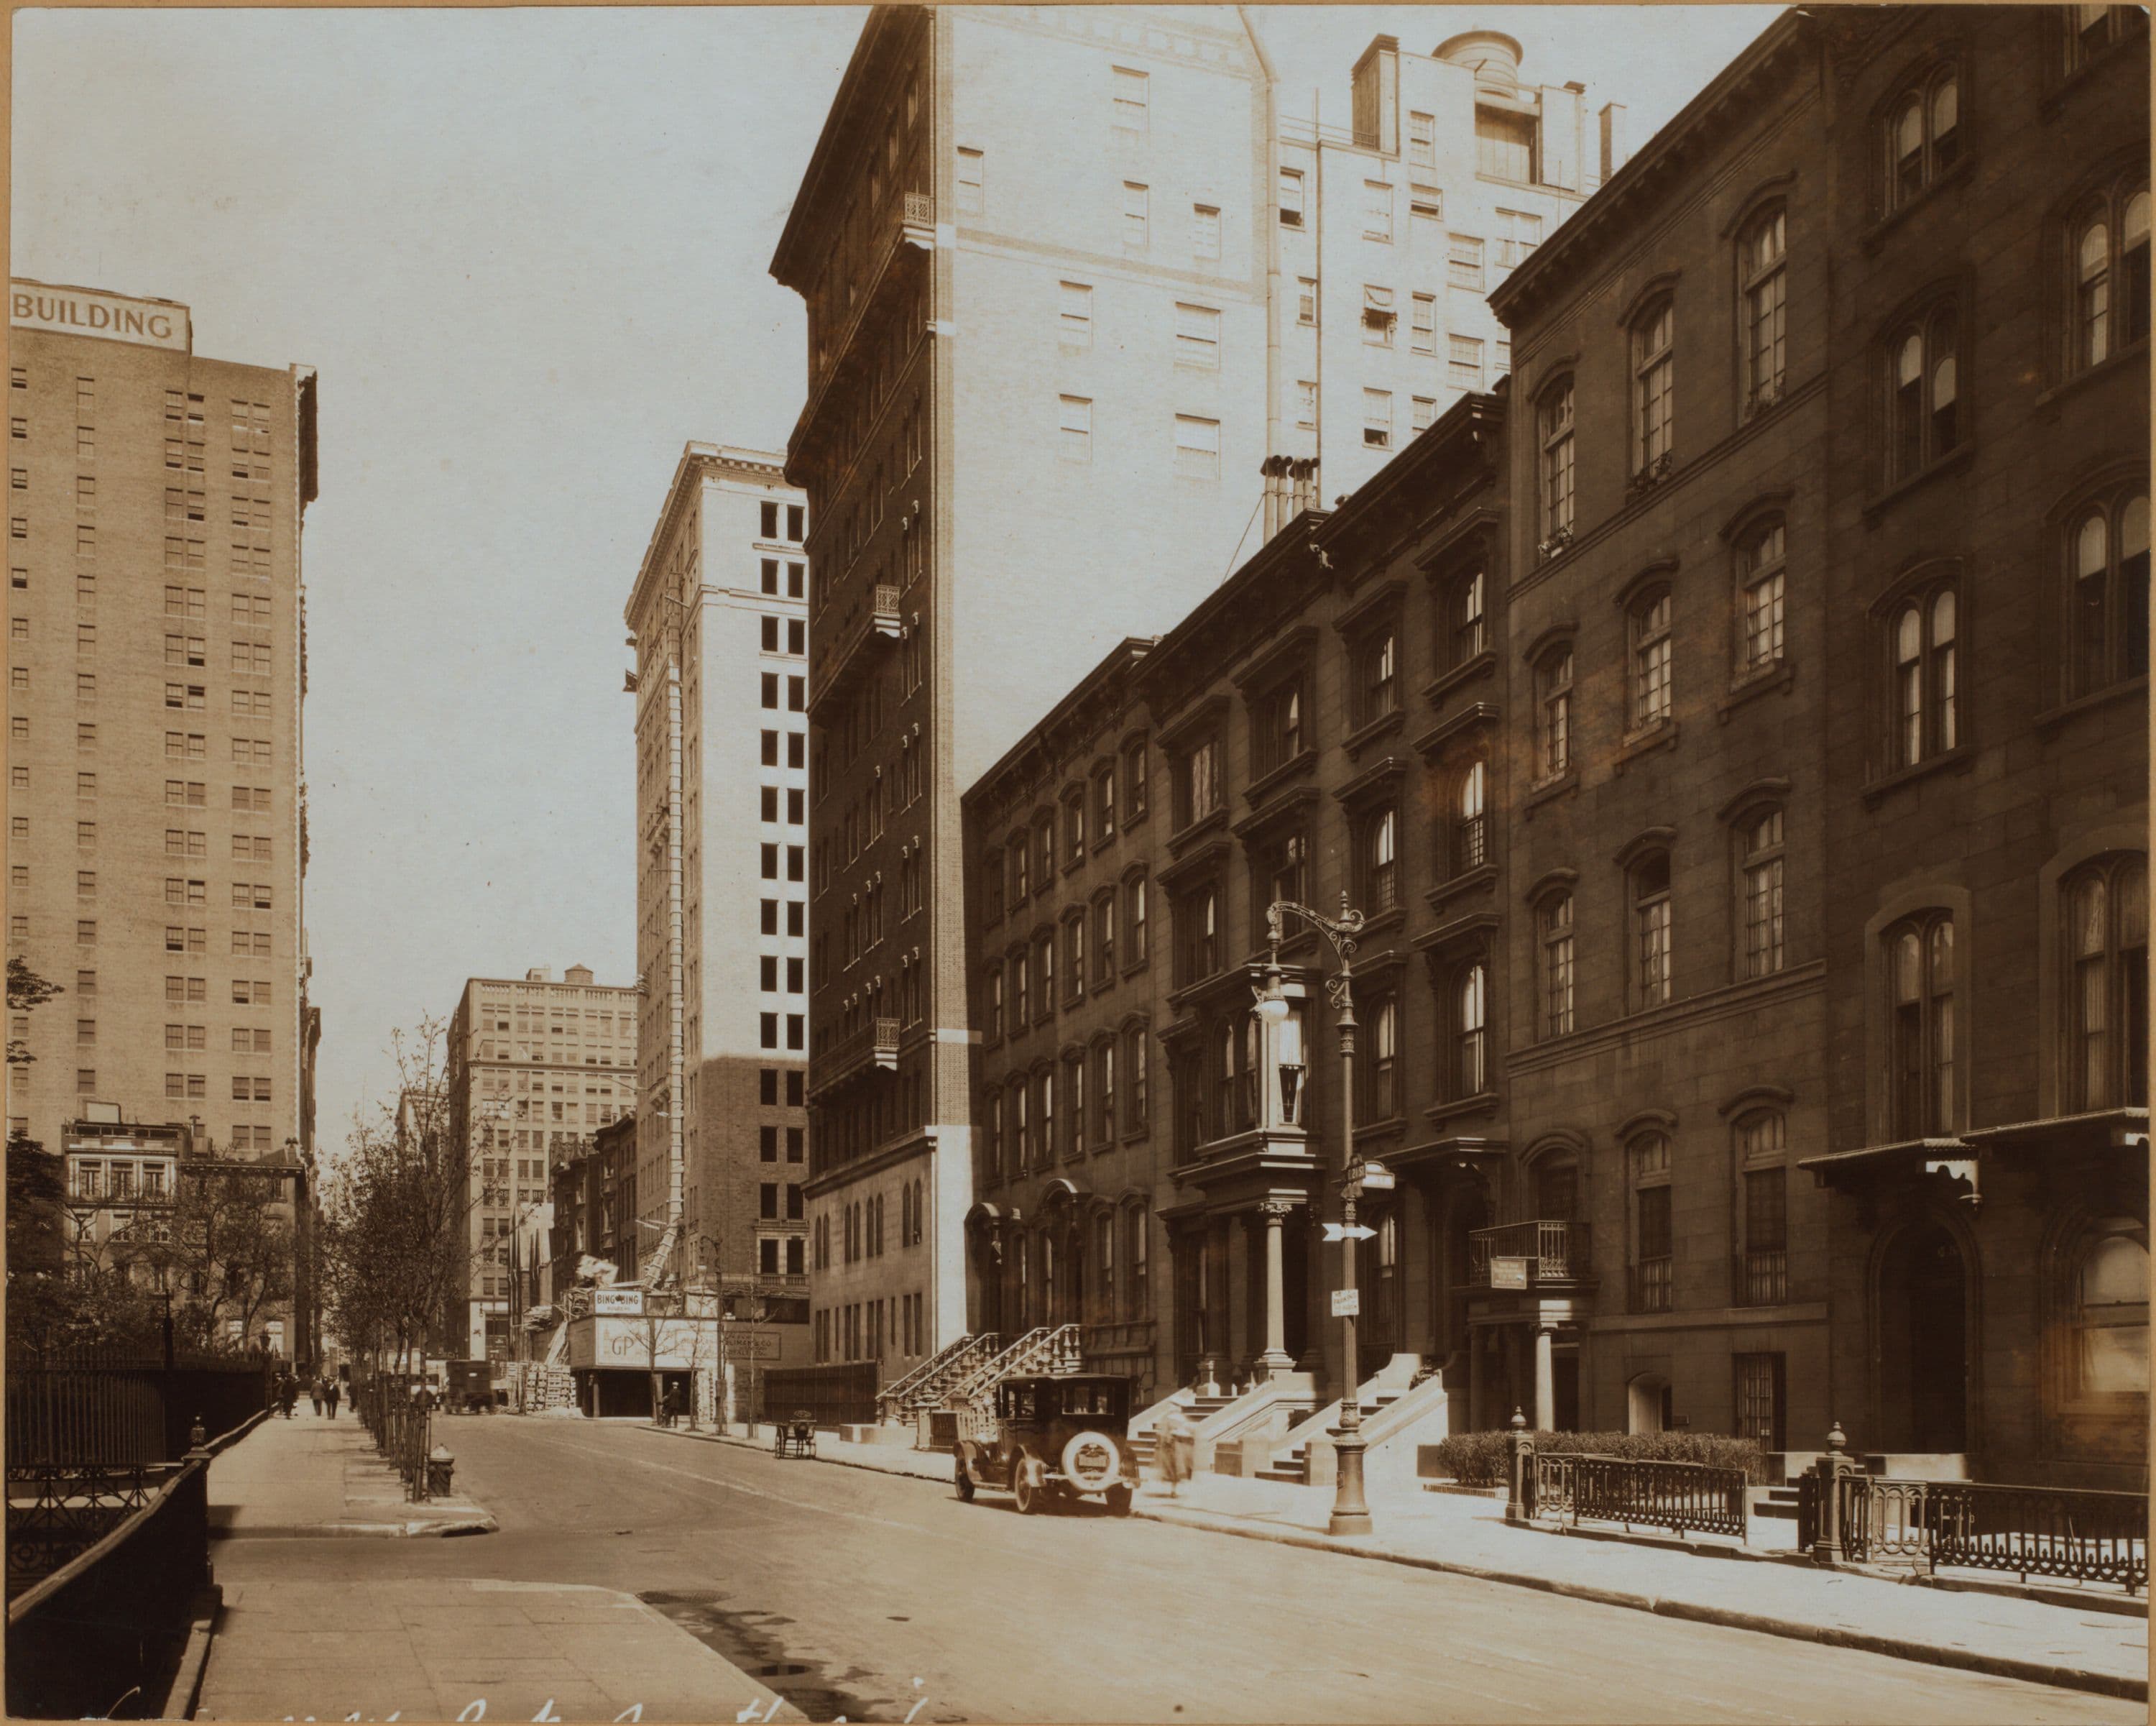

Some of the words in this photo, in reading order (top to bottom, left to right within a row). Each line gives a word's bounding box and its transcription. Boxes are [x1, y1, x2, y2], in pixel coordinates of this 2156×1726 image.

[12, 293, 172, 339] BUILDING
[597, 1294, 615, 1305] BING
[612, 1336, 634, 1356] GP
